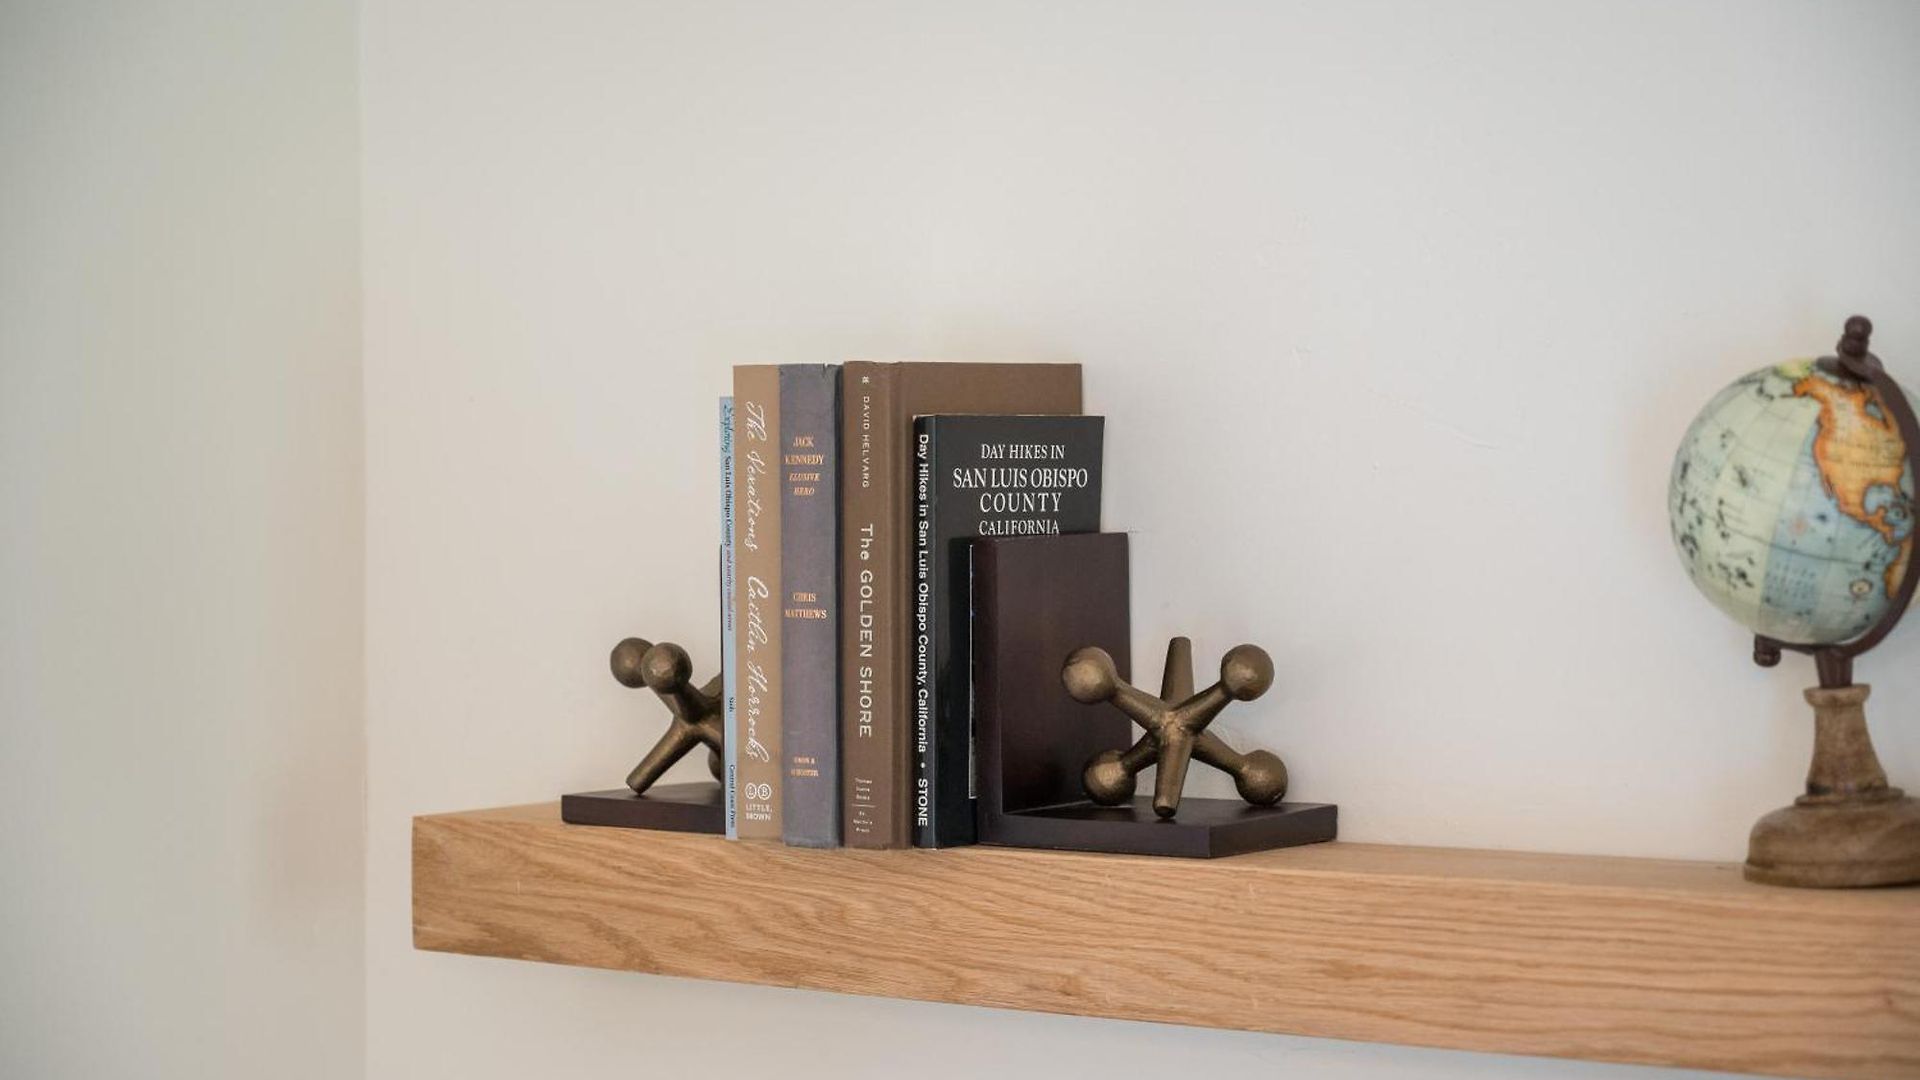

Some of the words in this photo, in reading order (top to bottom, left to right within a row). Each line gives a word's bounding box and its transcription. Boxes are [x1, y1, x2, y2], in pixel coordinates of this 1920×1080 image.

[746, 402, 766, 441] The
[862, 434, 870, 488] HELVARG
[918, 434, 929, 458] Day
[981, 444, 1006, 459] DAY
[1010, 444, 1048, 459] HIKES
[1051, 444, 1065, 459] IN
[918, 463, 929, 500] Hikes
[952, 467, 987, 488] SAN
[991, 468, 1028, 488] LUIS
[1031, 468, 1088, 488] OBISPO
[722, 490, 732, 518] Obispo
[744, 451, 766, 552] Vexations
[918, 504, 929, 516] in
[980, 492, 1062, 512] COUNTY
[860, 524, 874, 560] The
[918, 520, 929, 546] San
[979, 520, 1060, 536] CALIFORNIA
[918, 550, 929, 578] Luis
[747, 576, 769, 654] Caitlin
[859, 570, 874, 657] GOLDEN
[917, 582, 929, 631] Obispo
[916, 634, 928, 686] County,
[745, 660, 770, 762] Horrocks
[859, 666, 872, 738] SHORE
[918, 688, 928, 752] California
[918, 778, 928, 826] STONE
